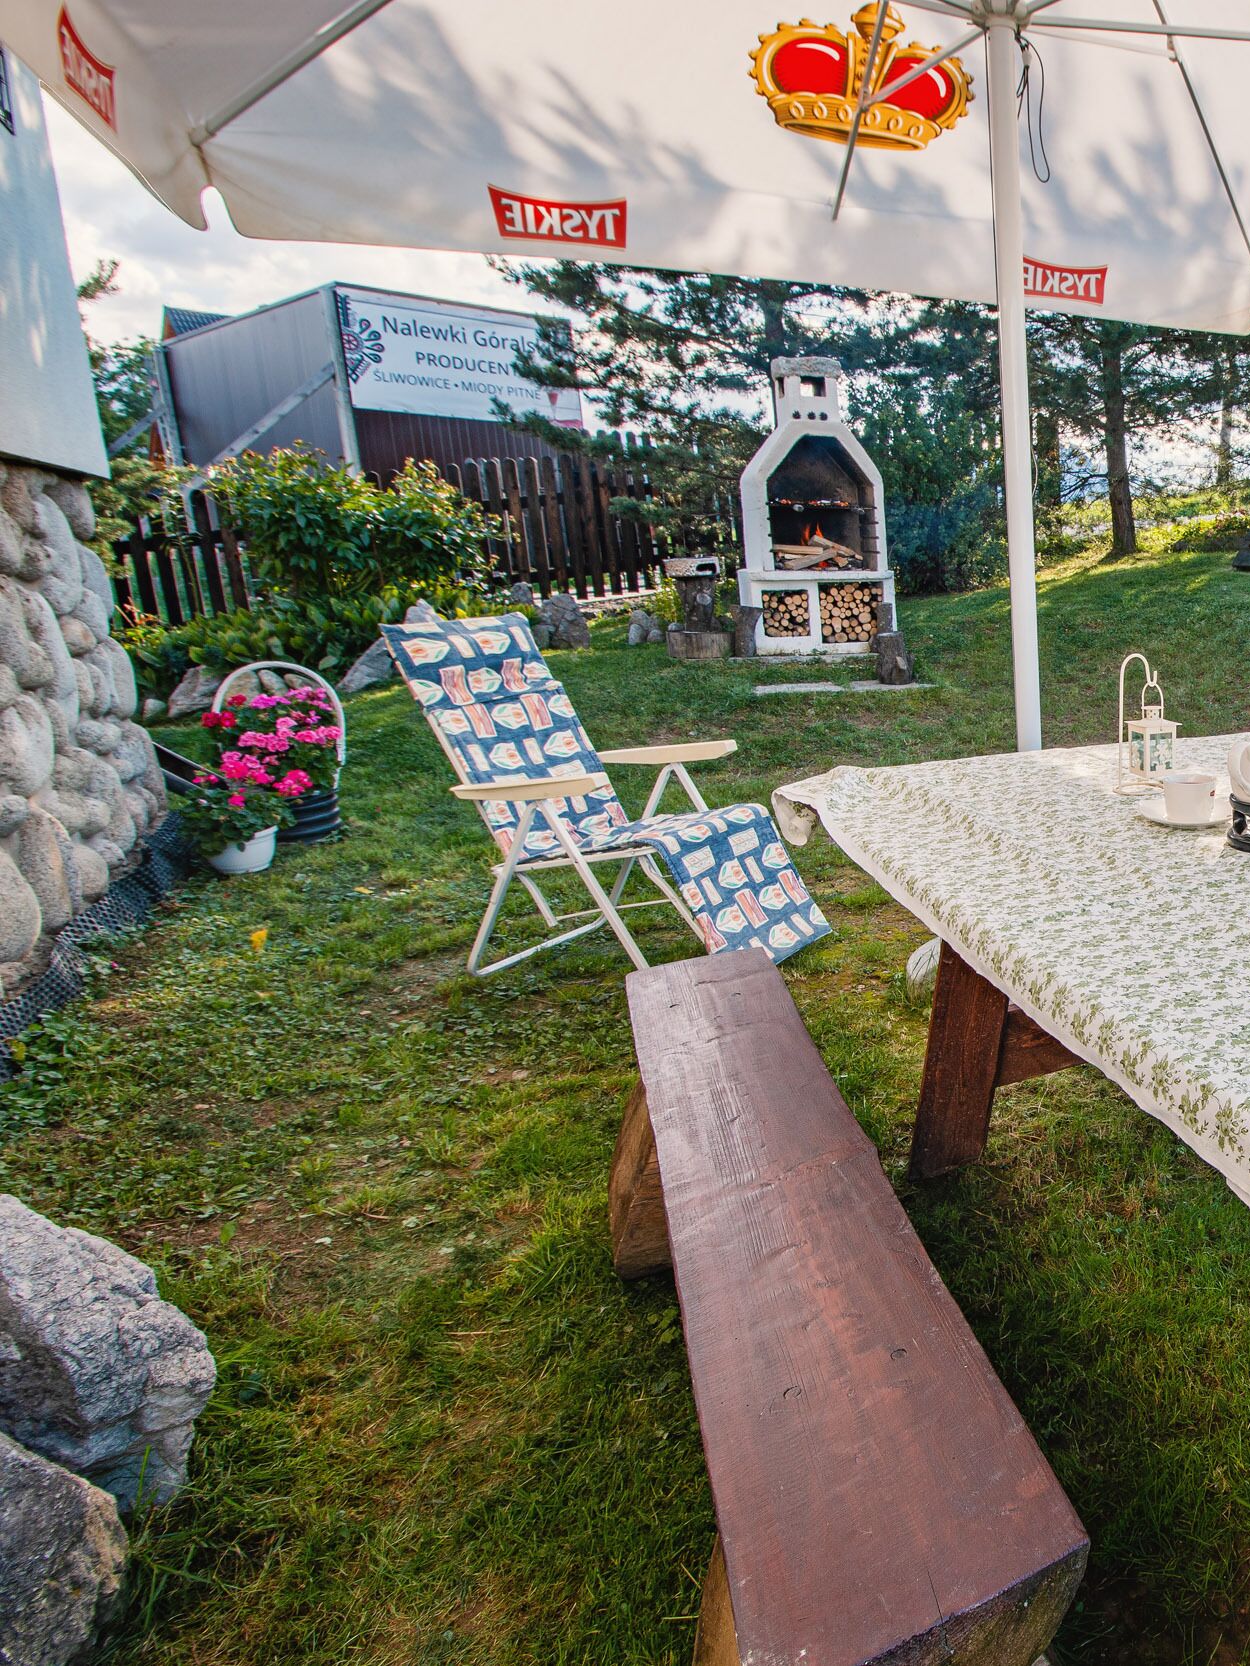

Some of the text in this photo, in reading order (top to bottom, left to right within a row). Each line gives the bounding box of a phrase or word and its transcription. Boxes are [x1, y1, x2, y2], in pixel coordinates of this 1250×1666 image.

[381, 315, 541, 353] Nalewki Górals
[415, 351, 518, 377] PRODUCEN
[373, 368, 541, 400] ŚLIWOWICE MIODY PITNE
